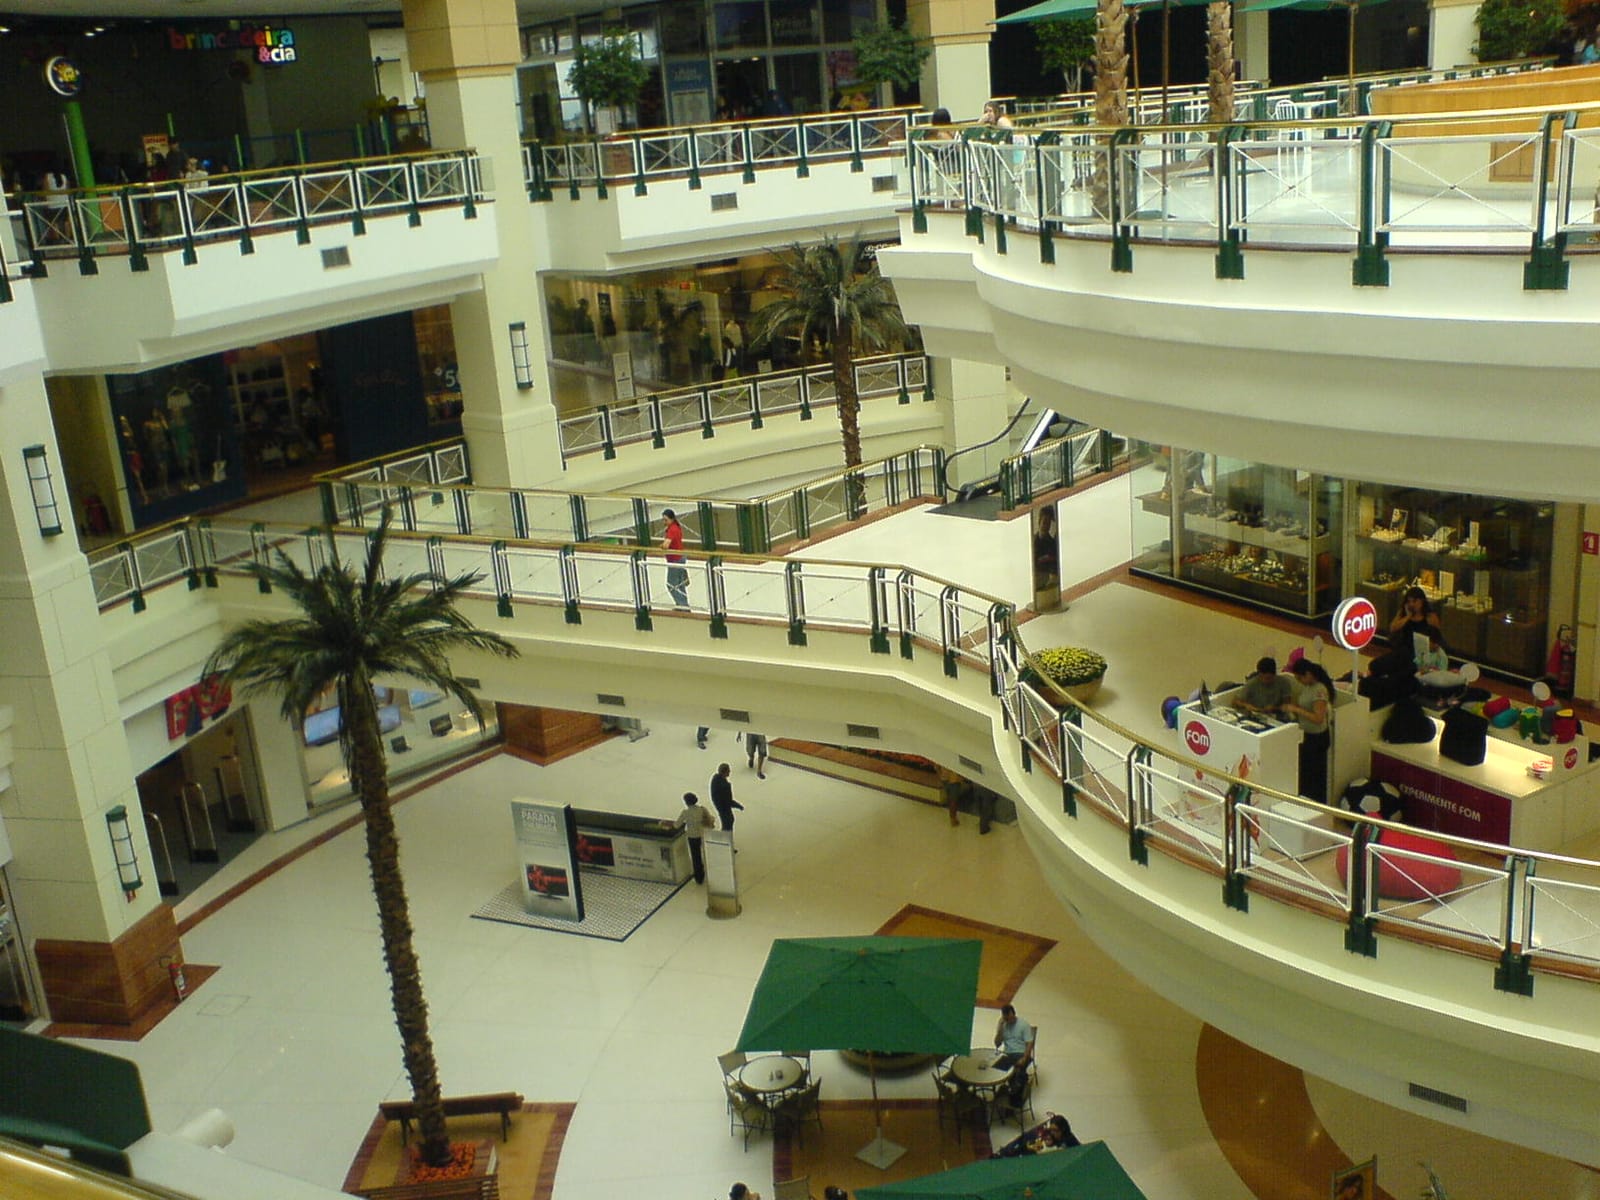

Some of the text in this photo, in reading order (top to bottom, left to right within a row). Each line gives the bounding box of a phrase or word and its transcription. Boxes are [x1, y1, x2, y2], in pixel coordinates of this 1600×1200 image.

[167, 25, 294, 49] brincdeira
[259, 43, 296, 62] &cia
[1458, 805, 1481, 823] FOM
